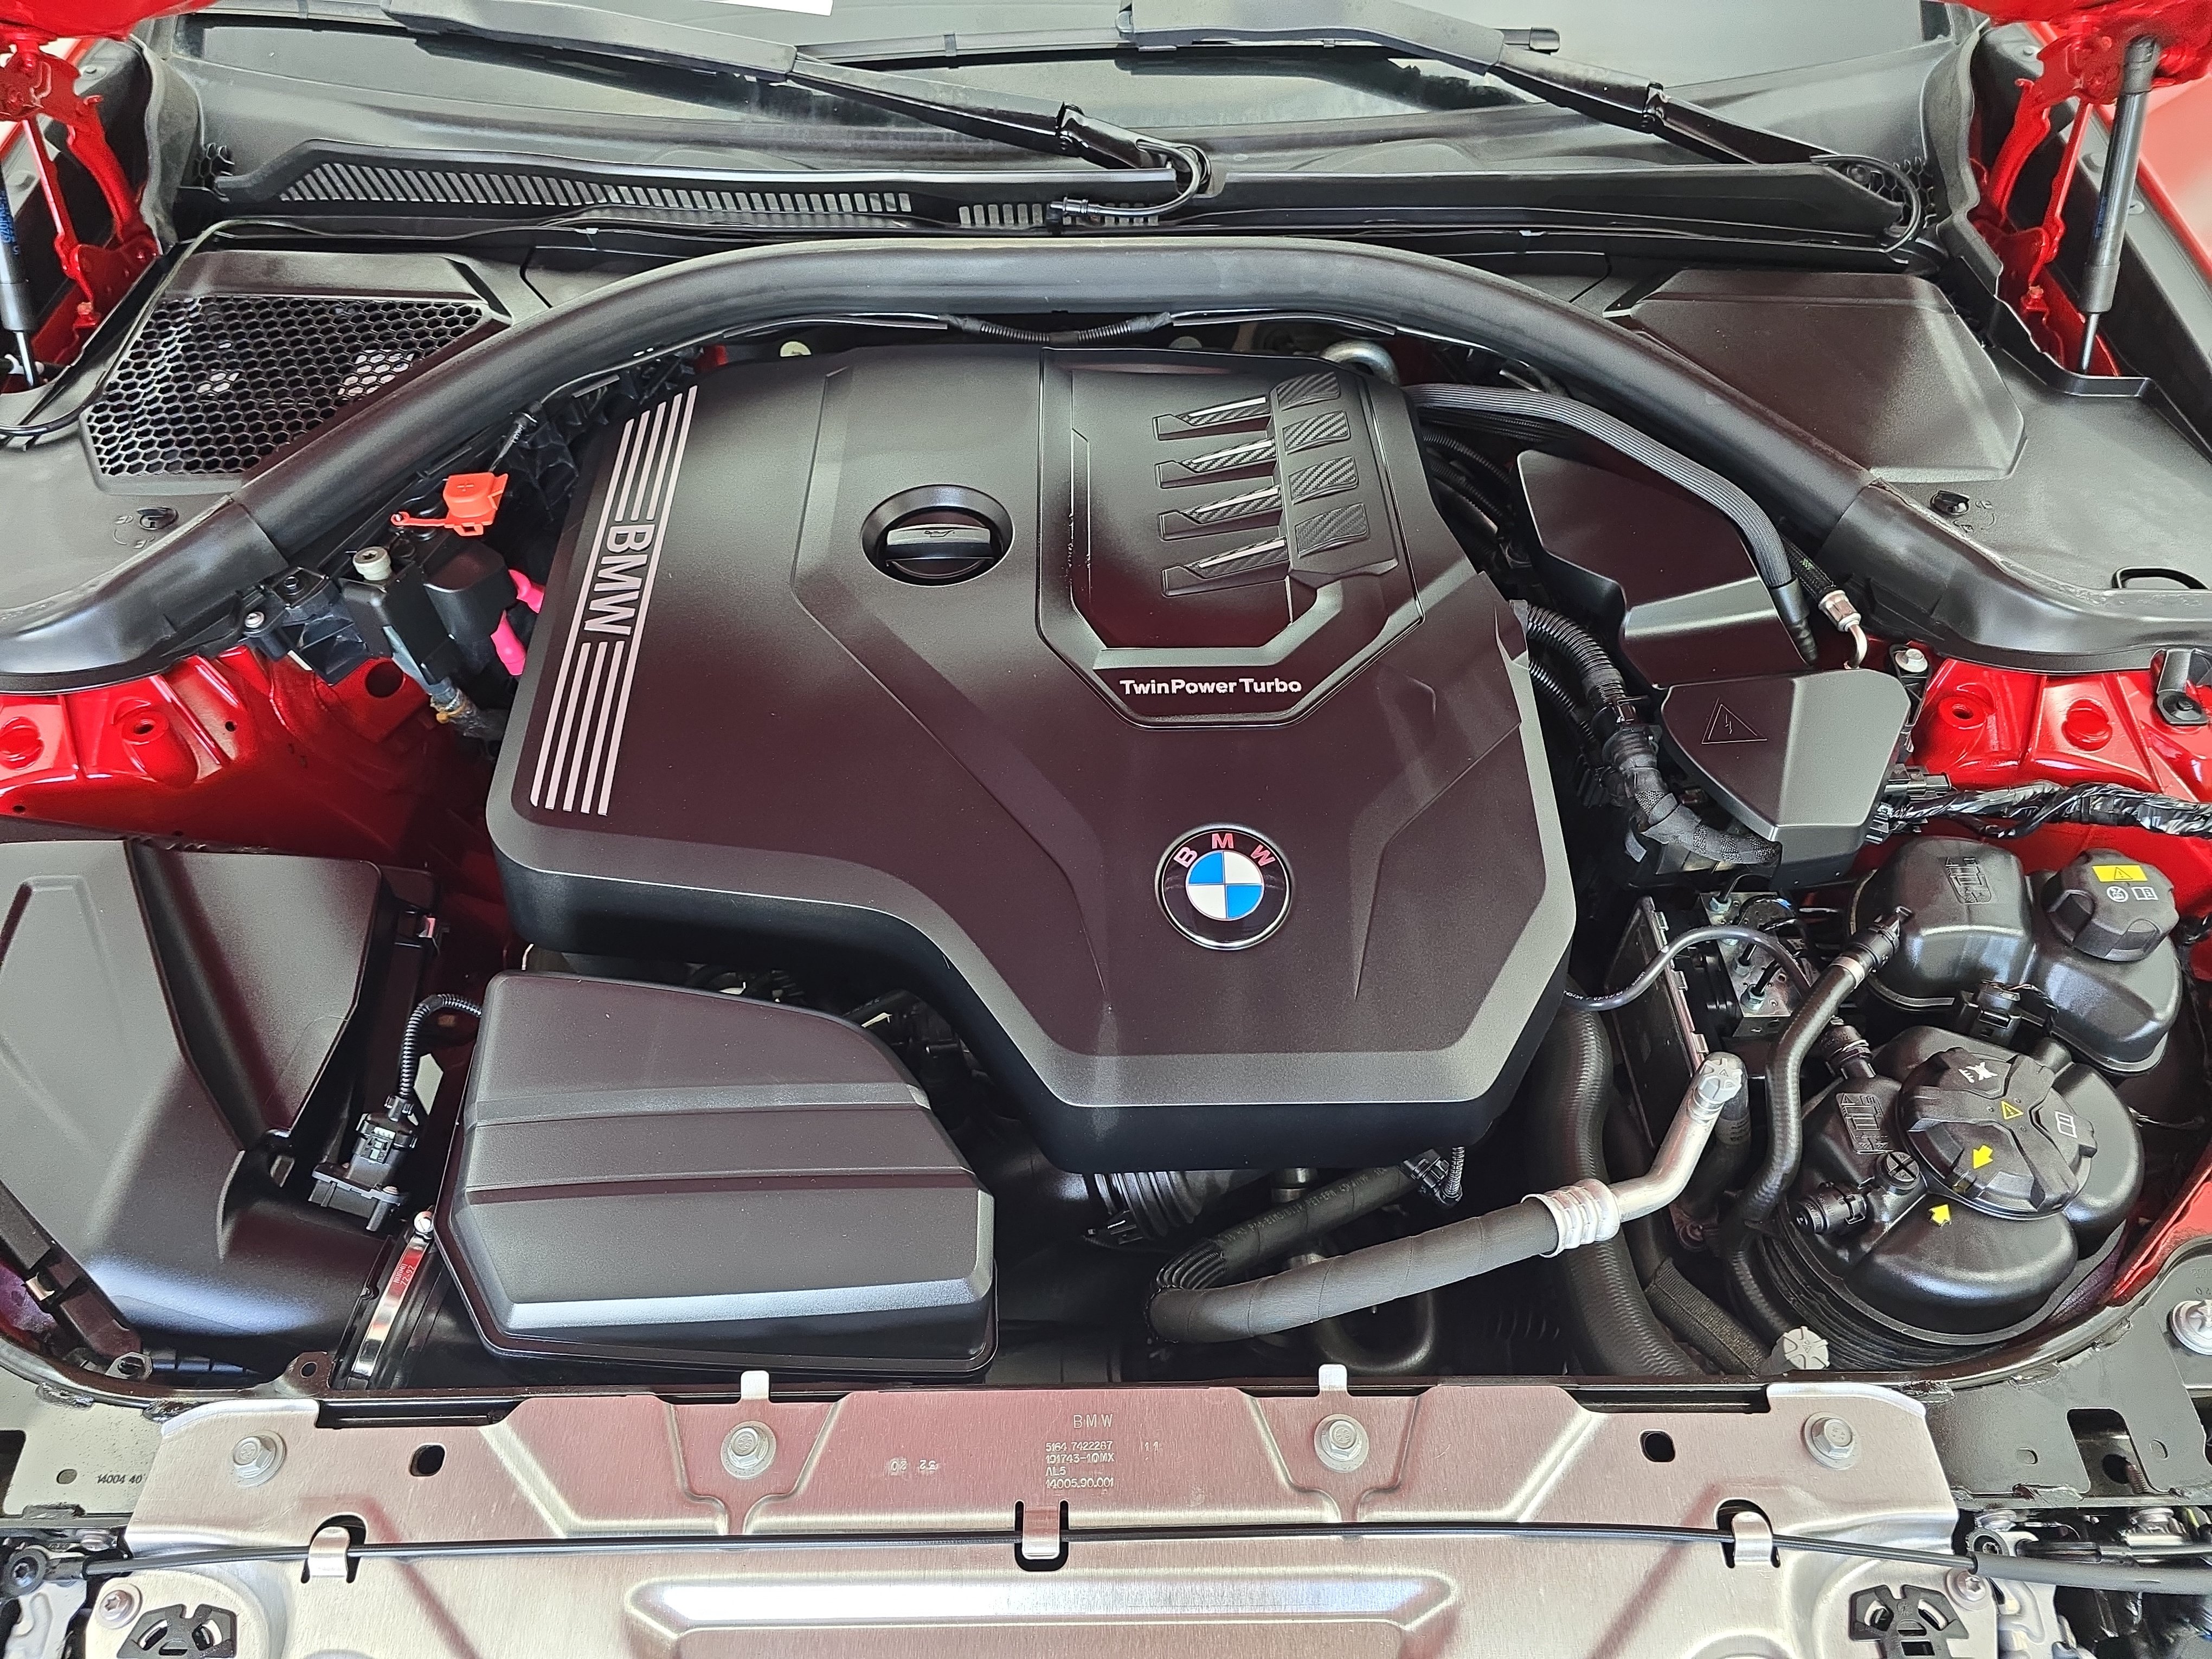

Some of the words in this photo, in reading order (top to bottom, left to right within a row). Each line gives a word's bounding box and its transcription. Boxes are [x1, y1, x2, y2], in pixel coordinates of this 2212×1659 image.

[584, 524, 655, 635] BMW
[1239, 678, 1302, 693] Turbo
[1173, 833, 1276, 868] BMW
[1073, 1413, 1113, 1428] BMW
[1045, 1442, 1068, 1452] 5164
[1071, 1441, 1113, 1451] 7422287
[1045, 1466, 1066, 1477] AL5
[97, 1474, 126, 1484] 14004
[1045, 1477, 1114, 1489] 14005.90.001
